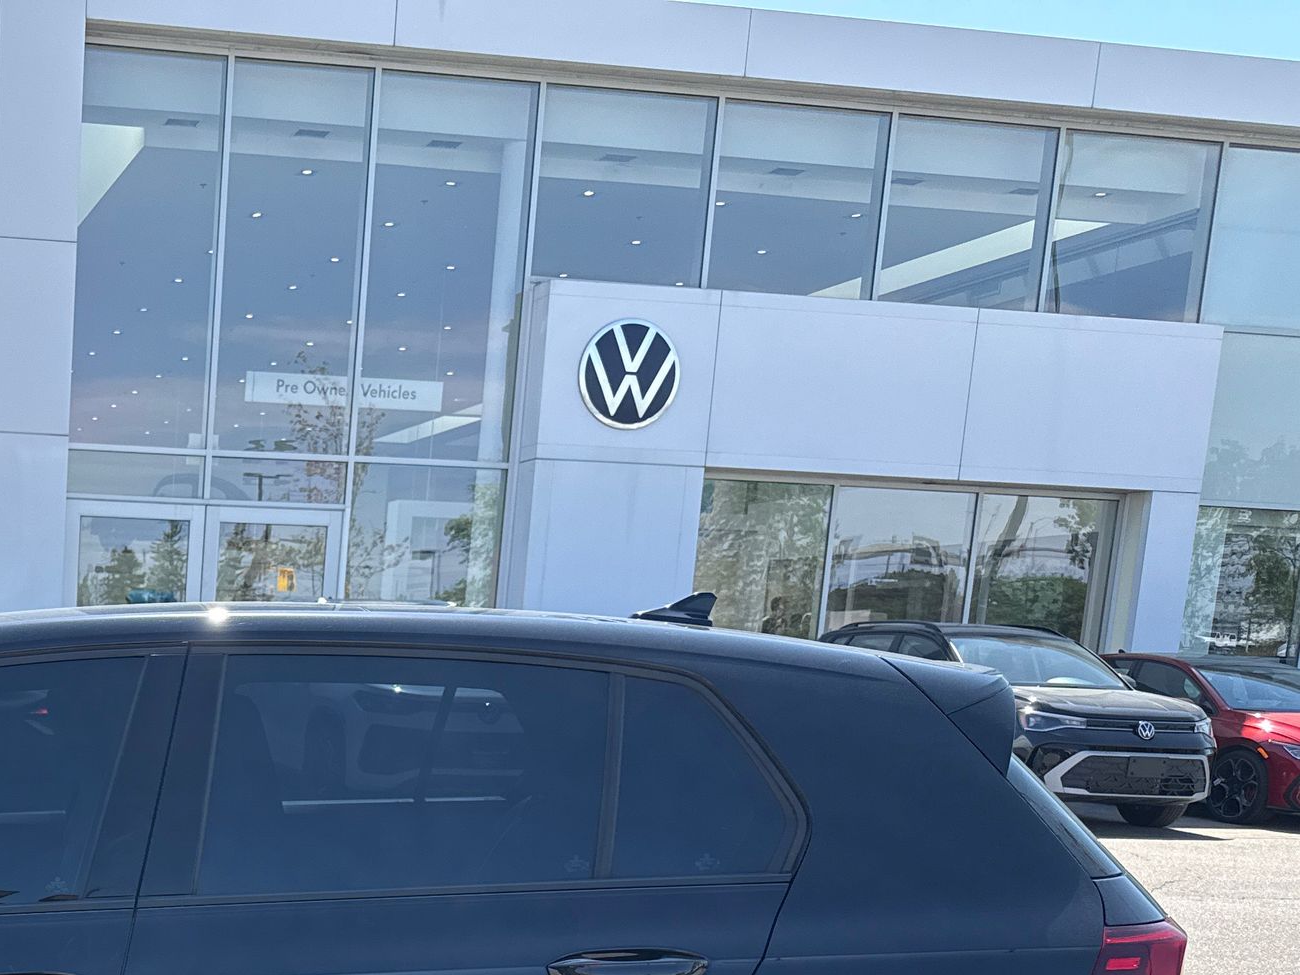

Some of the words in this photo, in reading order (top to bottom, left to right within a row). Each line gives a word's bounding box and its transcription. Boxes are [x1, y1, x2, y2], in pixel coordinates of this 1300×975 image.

[275, 378, 299, 394] Pre
[303, 379, 349, 396] Owne
[360, 383, 417, 400] Vehicles
[584, 321, 677, 420] VW
